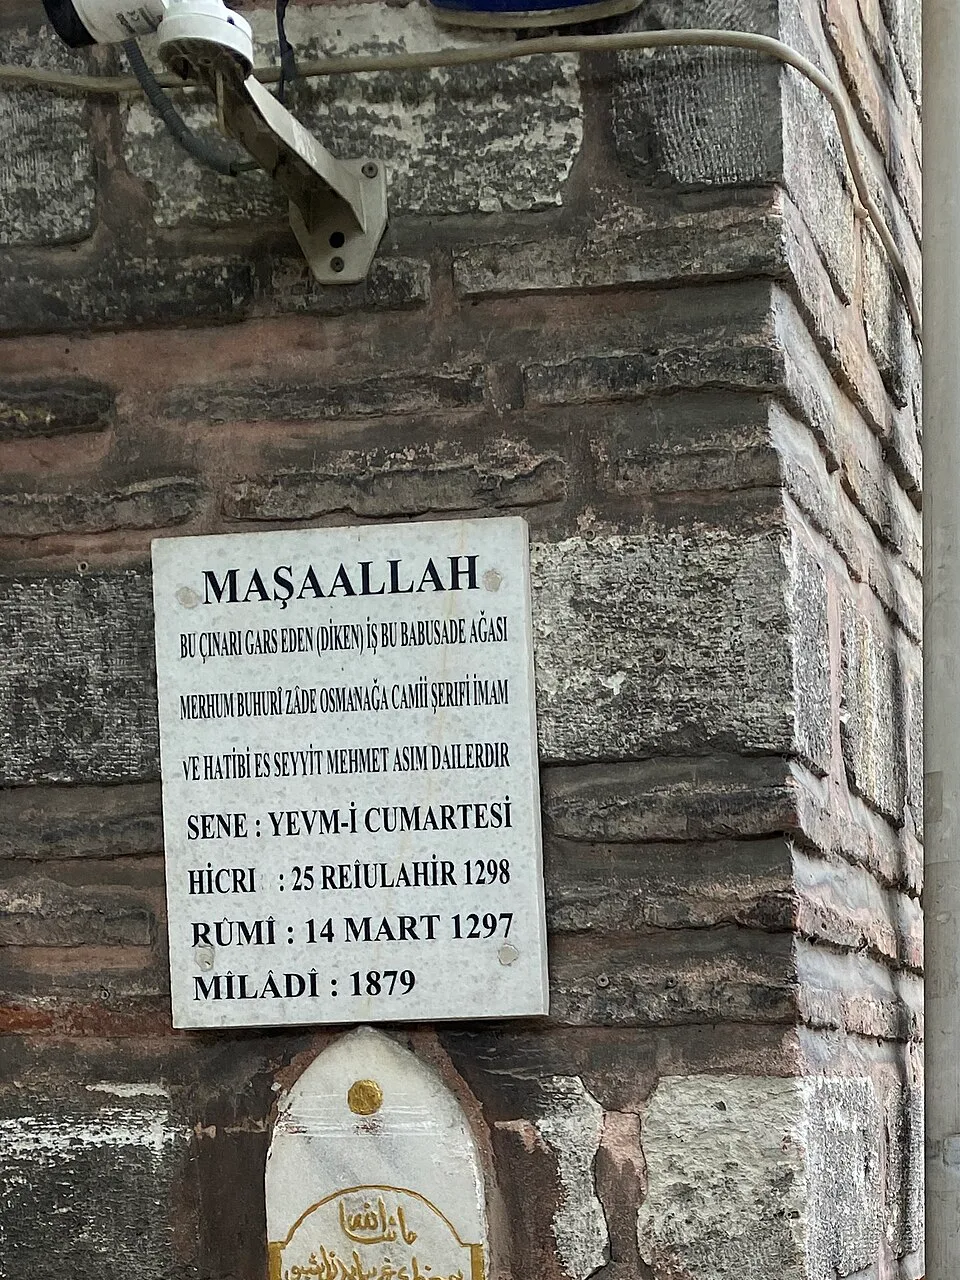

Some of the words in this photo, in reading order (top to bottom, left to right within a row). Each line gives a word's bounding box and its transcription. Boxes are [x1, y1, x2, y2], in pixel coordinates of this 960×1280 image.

[201, 555, 480, 610] MAŞAALLAH
[180, 633, 196, 659] BU
[199, 631, 243, 664] ÇINARI
[245, 628, 278, 656] GARS
[280, 627, 314, 654] EDEN
[316, 618, 364, 658] (DİKEN)
[366, 616, 378, 655] İŞ
[380, 622, 398, 648] BU
[400, 618, 466, 647] BABUSADE
[469, 610, 508, 644] AĞASI
[180, 693, 235, 721] MERHUM
[236, 686, 283, 718] BUHURÎ
[285, 685, 318, 715] ZÂDE
[319, 678, 389, 714] OSMANAĞA
[391, 675, 429, 710] CAMİİ
[472, 673, 509, 707] İMAM
[182, 755, 201, 781] VE
[203, 746, 252, 781] HATİBİ
[254, 752, 271, 778] ES
[273, 743, 324, 777] SEYYİT
[326, 747, 390, 775] MEHMET
[392, 745, 428, 772] ASIM
[431, 742, 511, 770] DAILERDIR
[187, 813, 248, 841] SENE
[267, 801, 358, 837] YEVM-İ
[364, 794, 513, 833] CUMARTESİ
[187, 862, 257, 895] HİCRI
[291, 865, 315, 891] 25
[320, 854, 458, 891] REÎULAHİR
[463, 858, 511, 886] 1298
[191, 915, 276, 948] RÛMÎ
[305, 917, 335, 944] 14
[344, 915, 441, 943] MART
[451, 912, 514, 940] 1297
[192, 967, 320, 1001] MÎLÂDÎ
[349, 969, 416, 998] 1879
